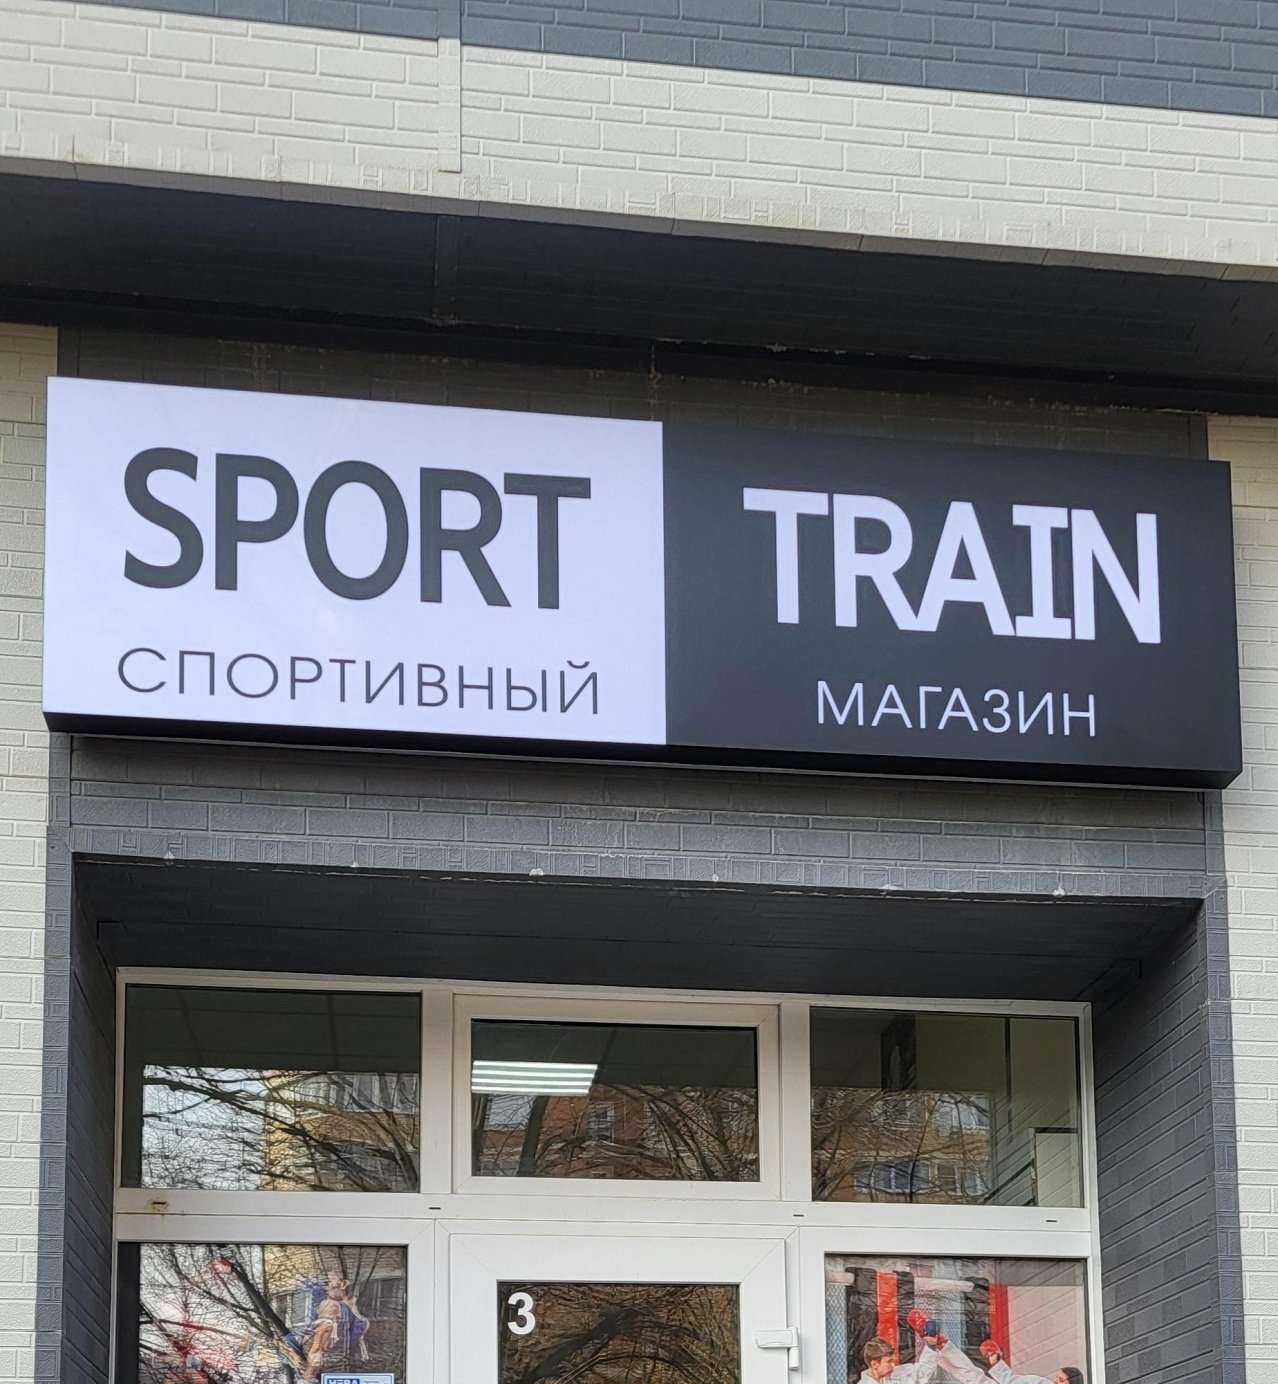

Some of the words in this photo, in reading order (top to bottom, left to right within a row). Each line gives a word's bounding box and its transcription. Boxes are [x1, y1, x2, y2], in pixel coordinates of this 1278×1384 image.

[124, 447, 591, 610] SPORT
[743, 488, 1161, 644] TRAIN
[117, 647, 599, 715] СПОРТИВНЫЙ
[818, 681, 1096, 737] МАГАЗИН
[508, 1292, 535, 1335] 3
